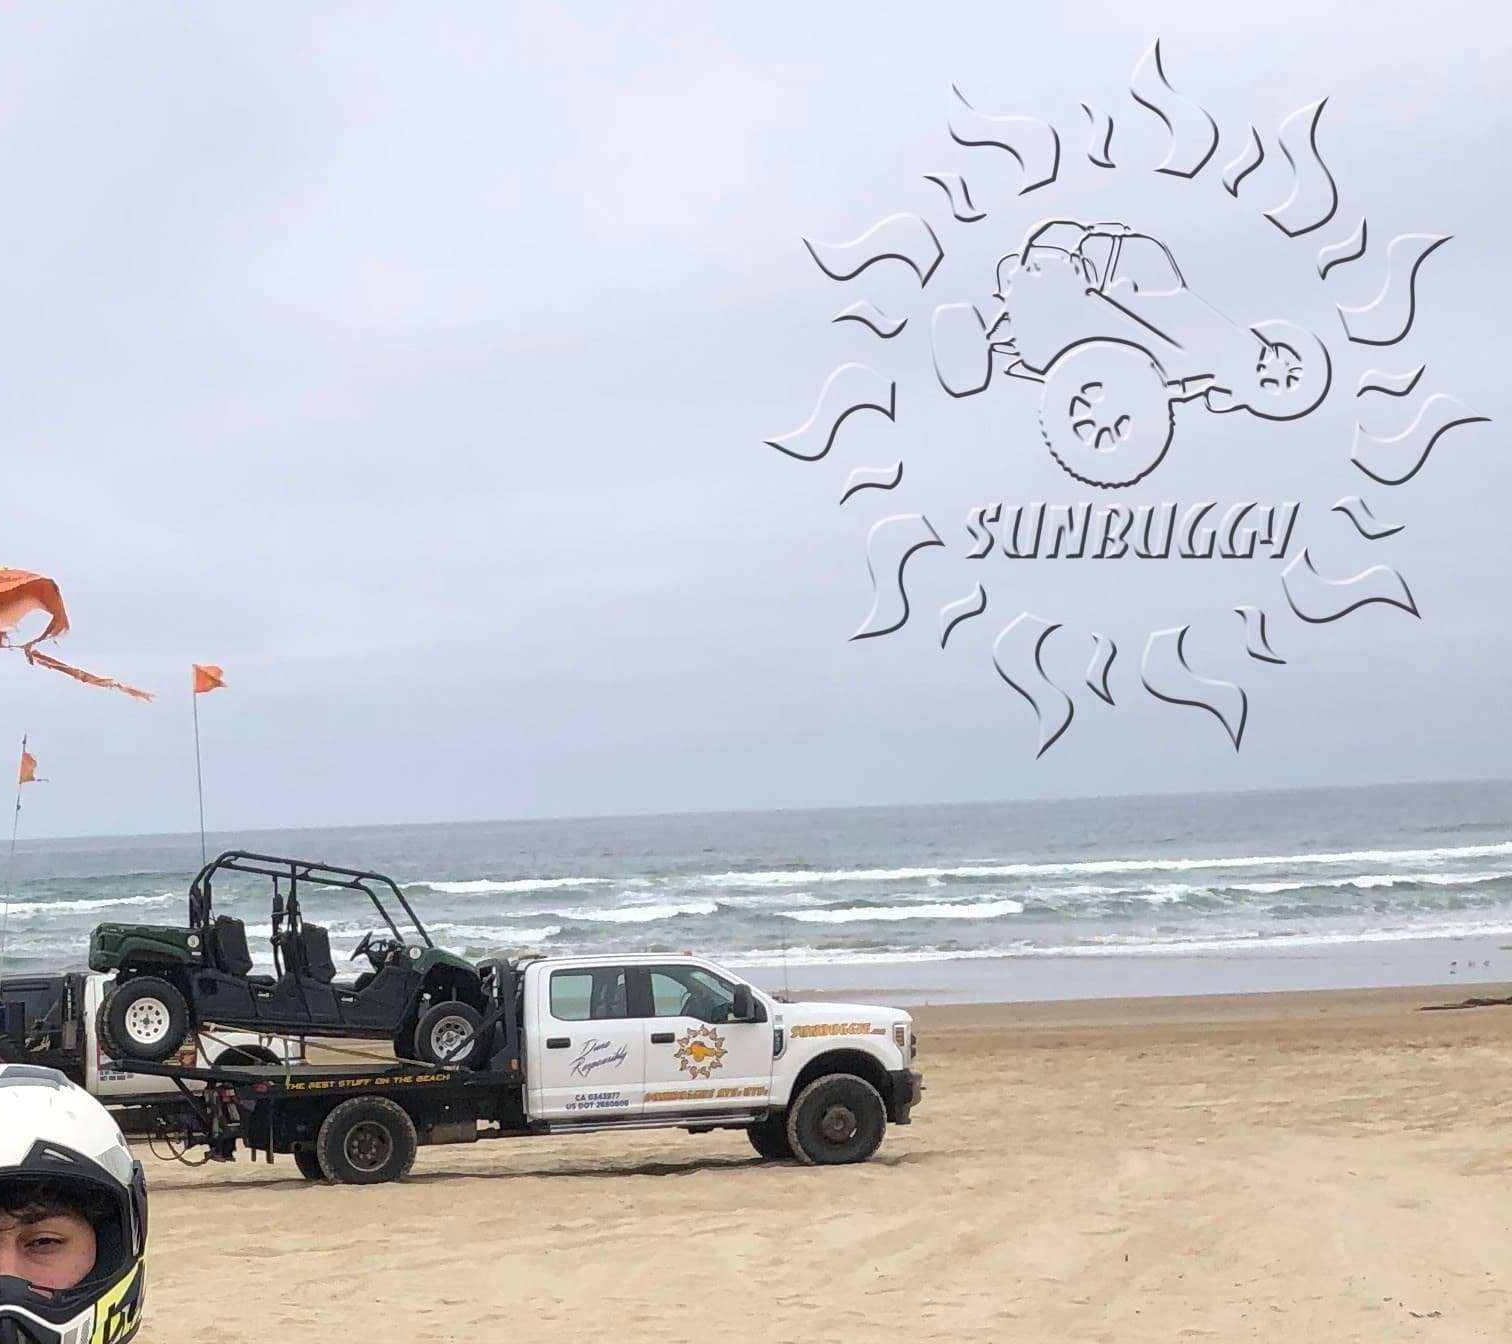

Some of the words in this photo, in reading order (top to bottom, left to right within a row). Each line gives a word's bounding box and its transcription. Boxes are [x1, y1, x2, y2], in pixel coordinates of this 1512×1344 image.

[286, 1082, 305, 1091] THE
[308, 1080, 335, 1090] BEST
[338, 1078, 371, 1088] STUFF
[374, 1077, 391, 1085] ON
[393, 1076, 413, 1084] THE
[415, 1073, 450, 1083] BEACH
[575, 1094, 586, 1102] CA
